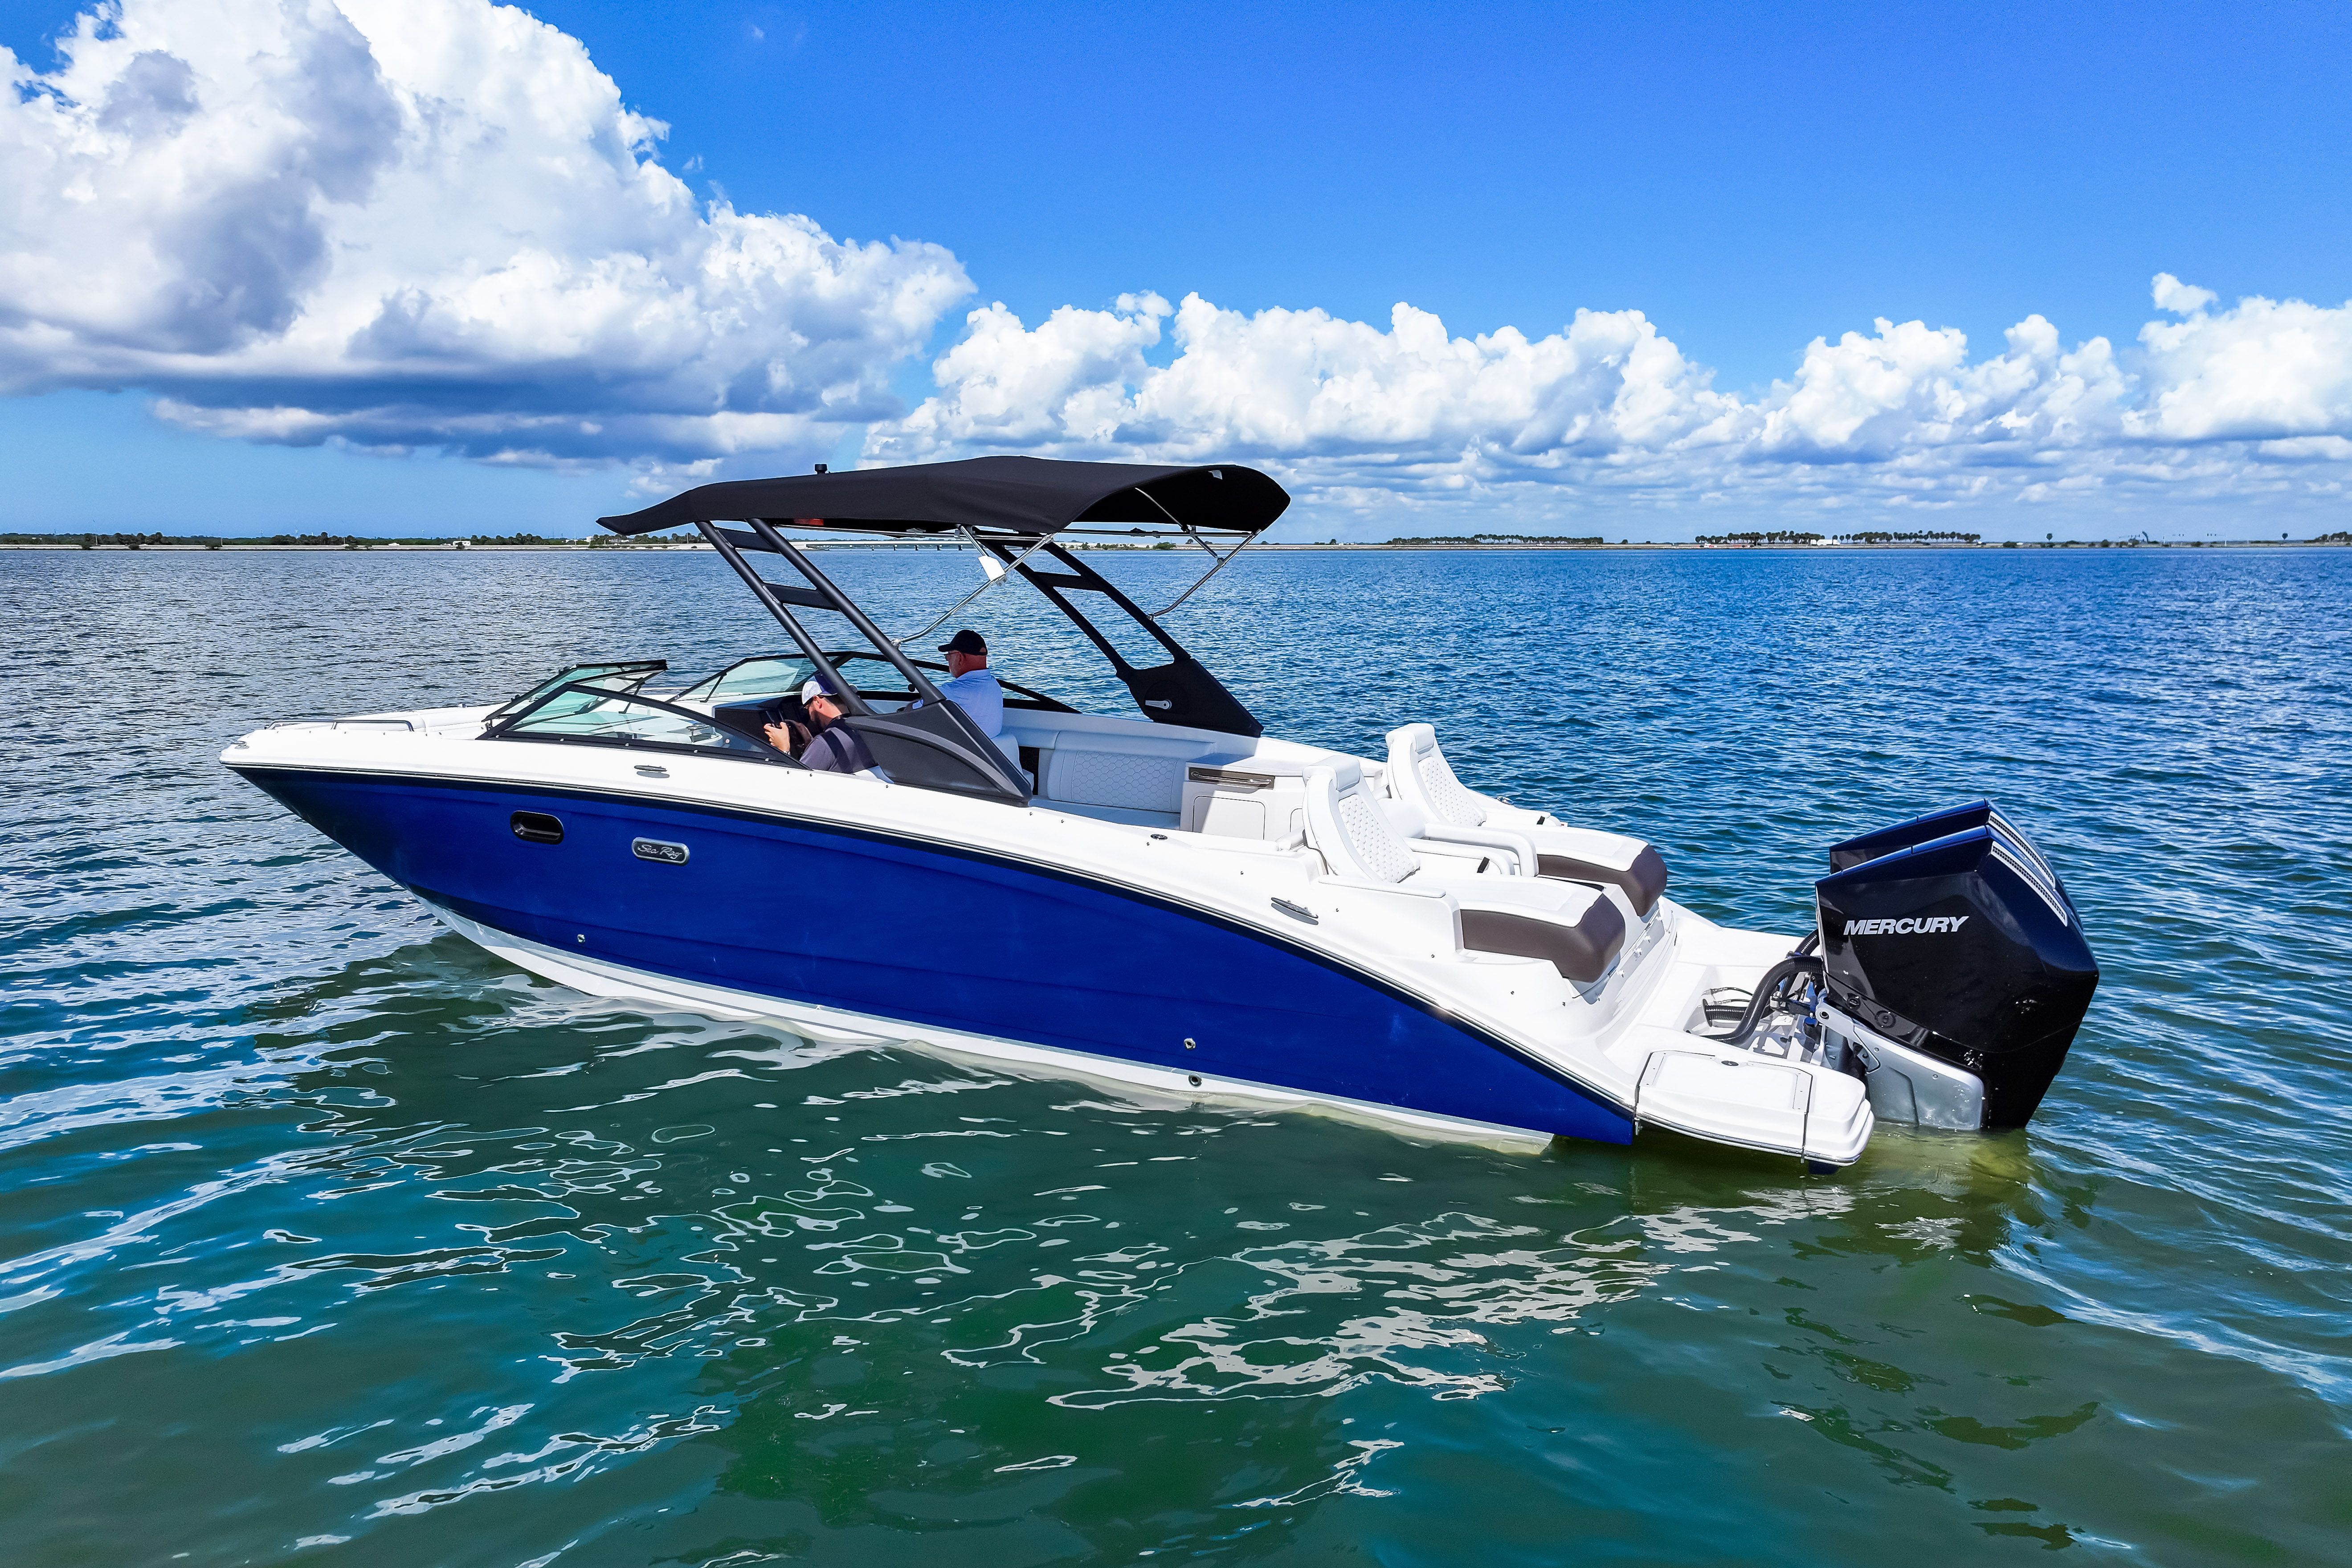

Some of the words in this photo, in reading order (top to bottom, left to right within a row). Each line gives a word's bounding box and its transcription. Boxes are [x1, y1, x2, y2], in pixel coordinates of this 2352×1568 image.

[637, 845, 659, 853] Sea
[660, 847, 682, 859] Ray
[1843, 916, 1969, 935] MERCURY
